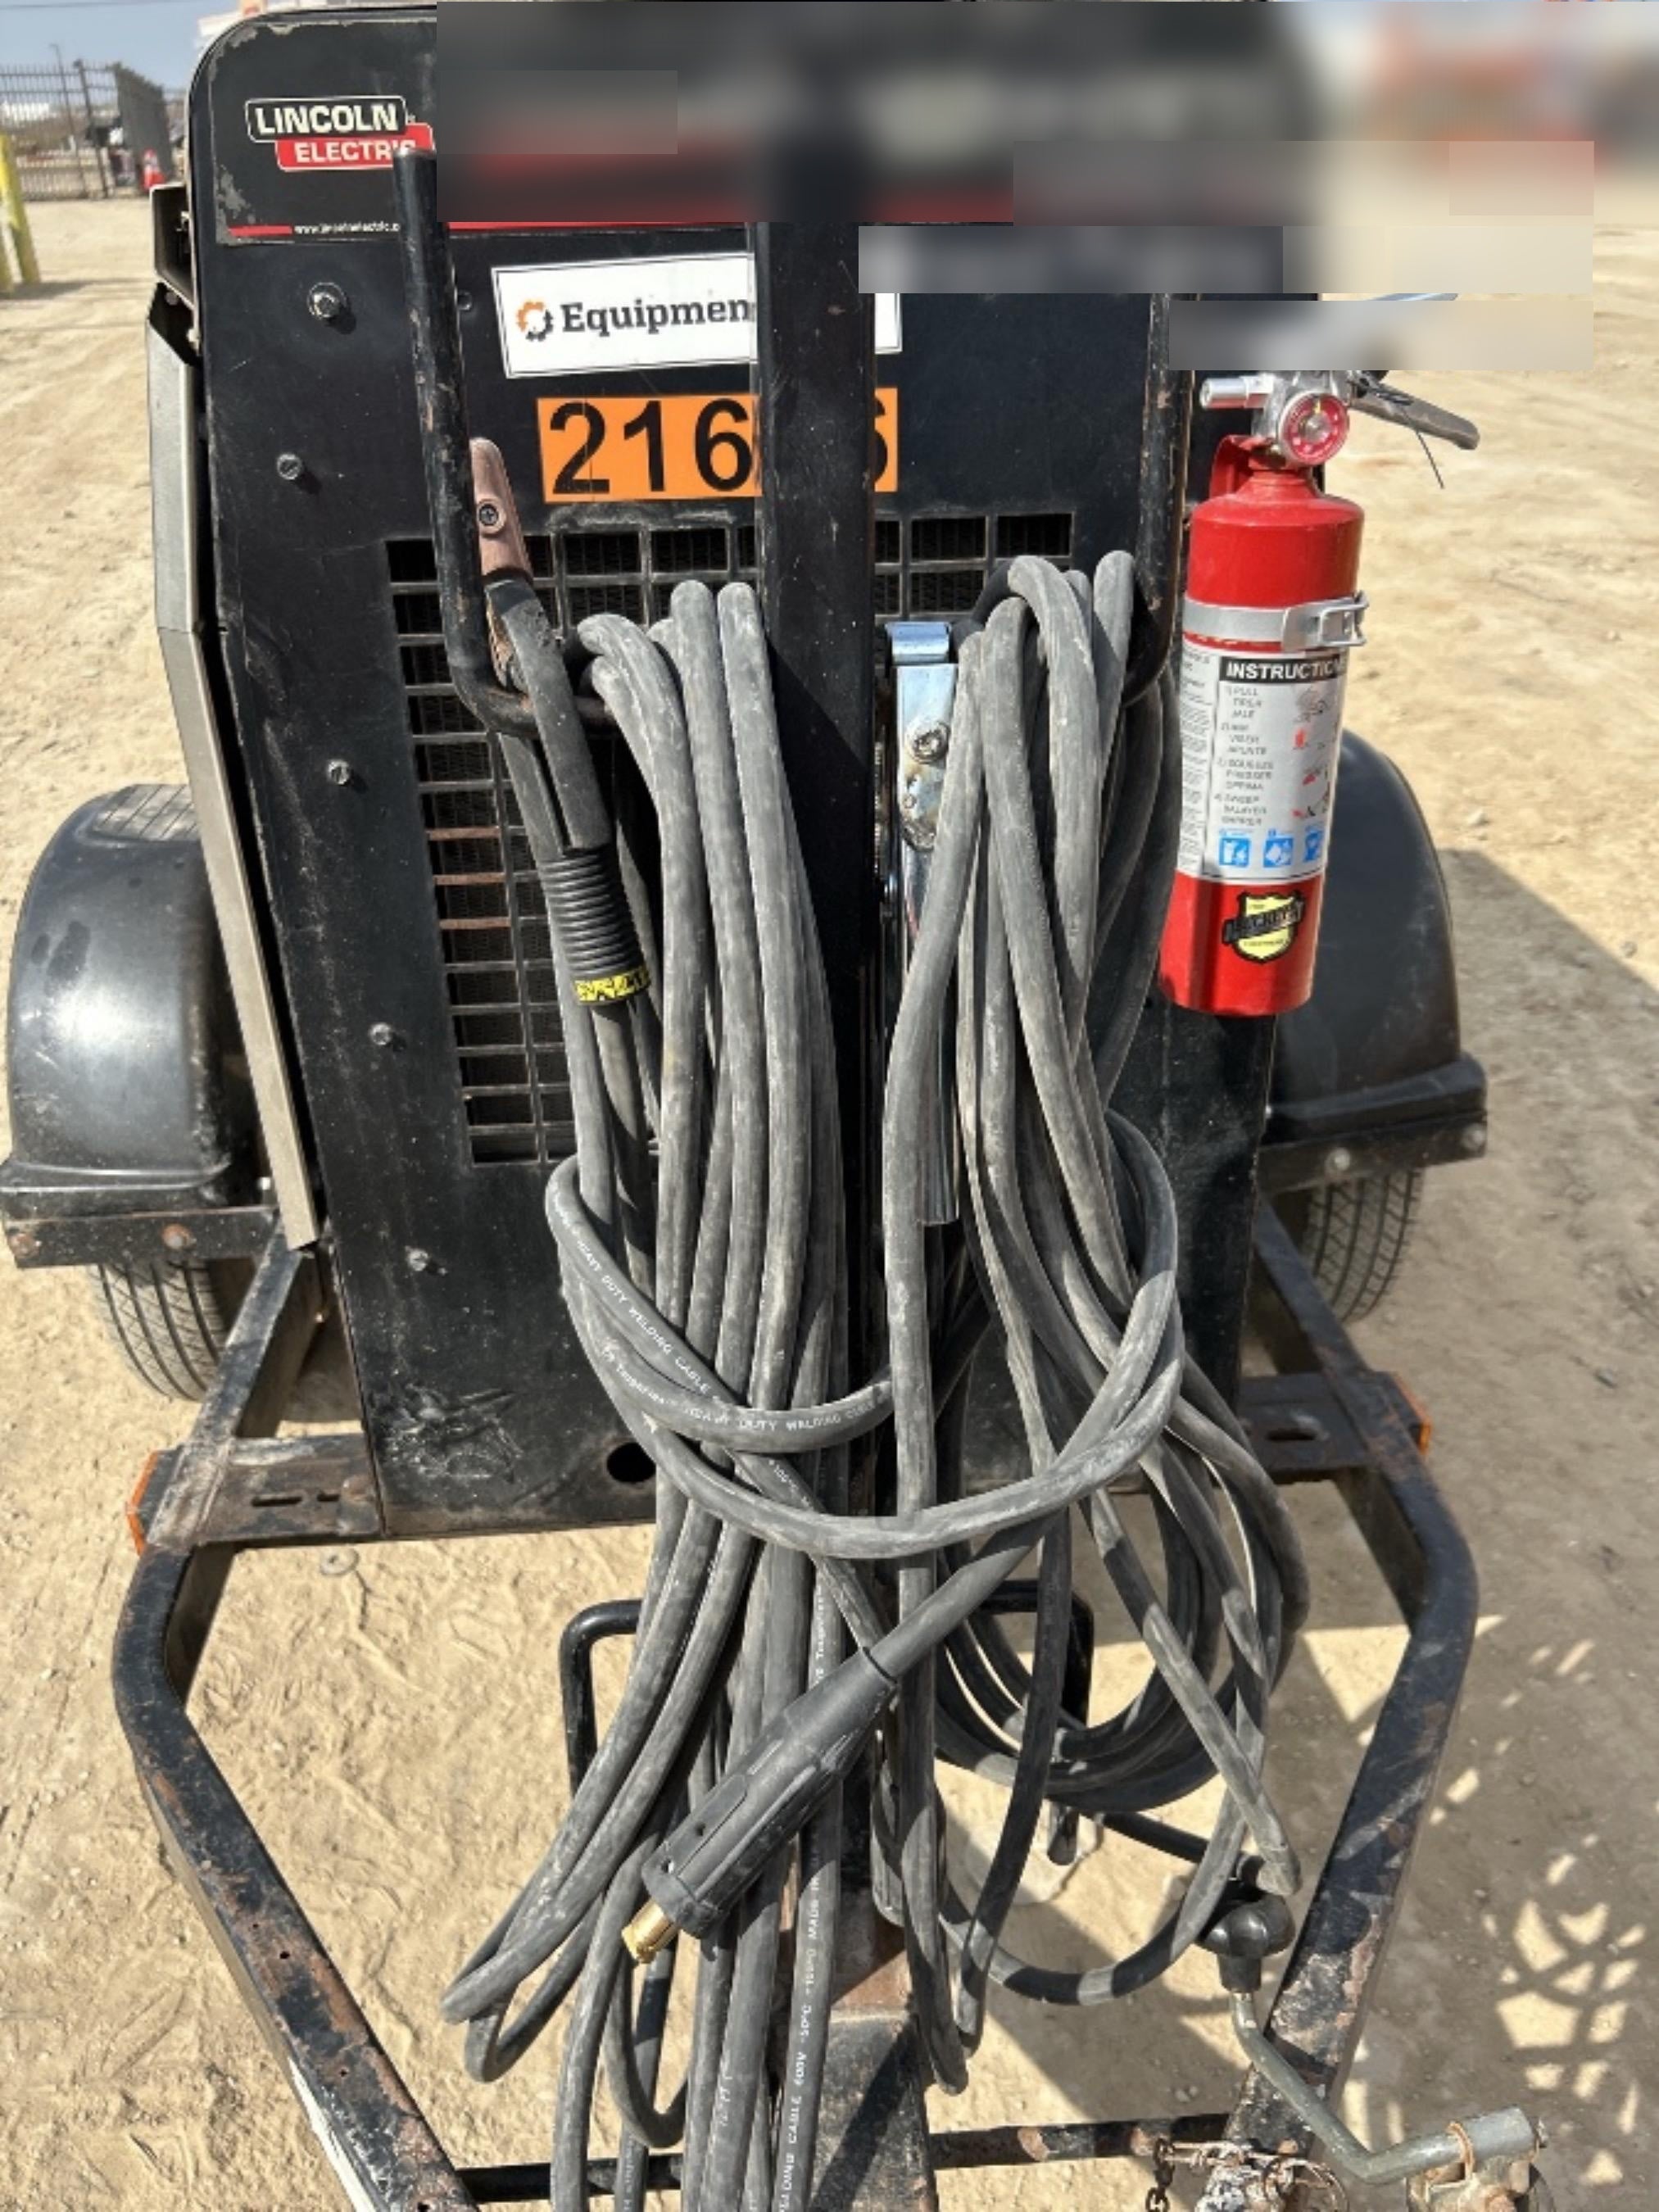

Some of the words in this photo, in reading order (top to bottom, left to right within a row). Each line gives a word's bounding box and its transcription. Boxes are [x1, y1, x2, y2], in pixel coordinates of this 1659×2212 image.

[254, 103, 400, 136] LINCOLN
[560, 297, 756, 338] Equipmen
[549, 397, 889, 495] 216
[601, 1275, 630, 1304] DUTY
[628, 1306, 674, 1355] WELDING
[674, 1355, 712, 1394] CABLE
[738, 1416, 778, 1431] DUTY
[788, 2096, 802, 2145] CABLE
